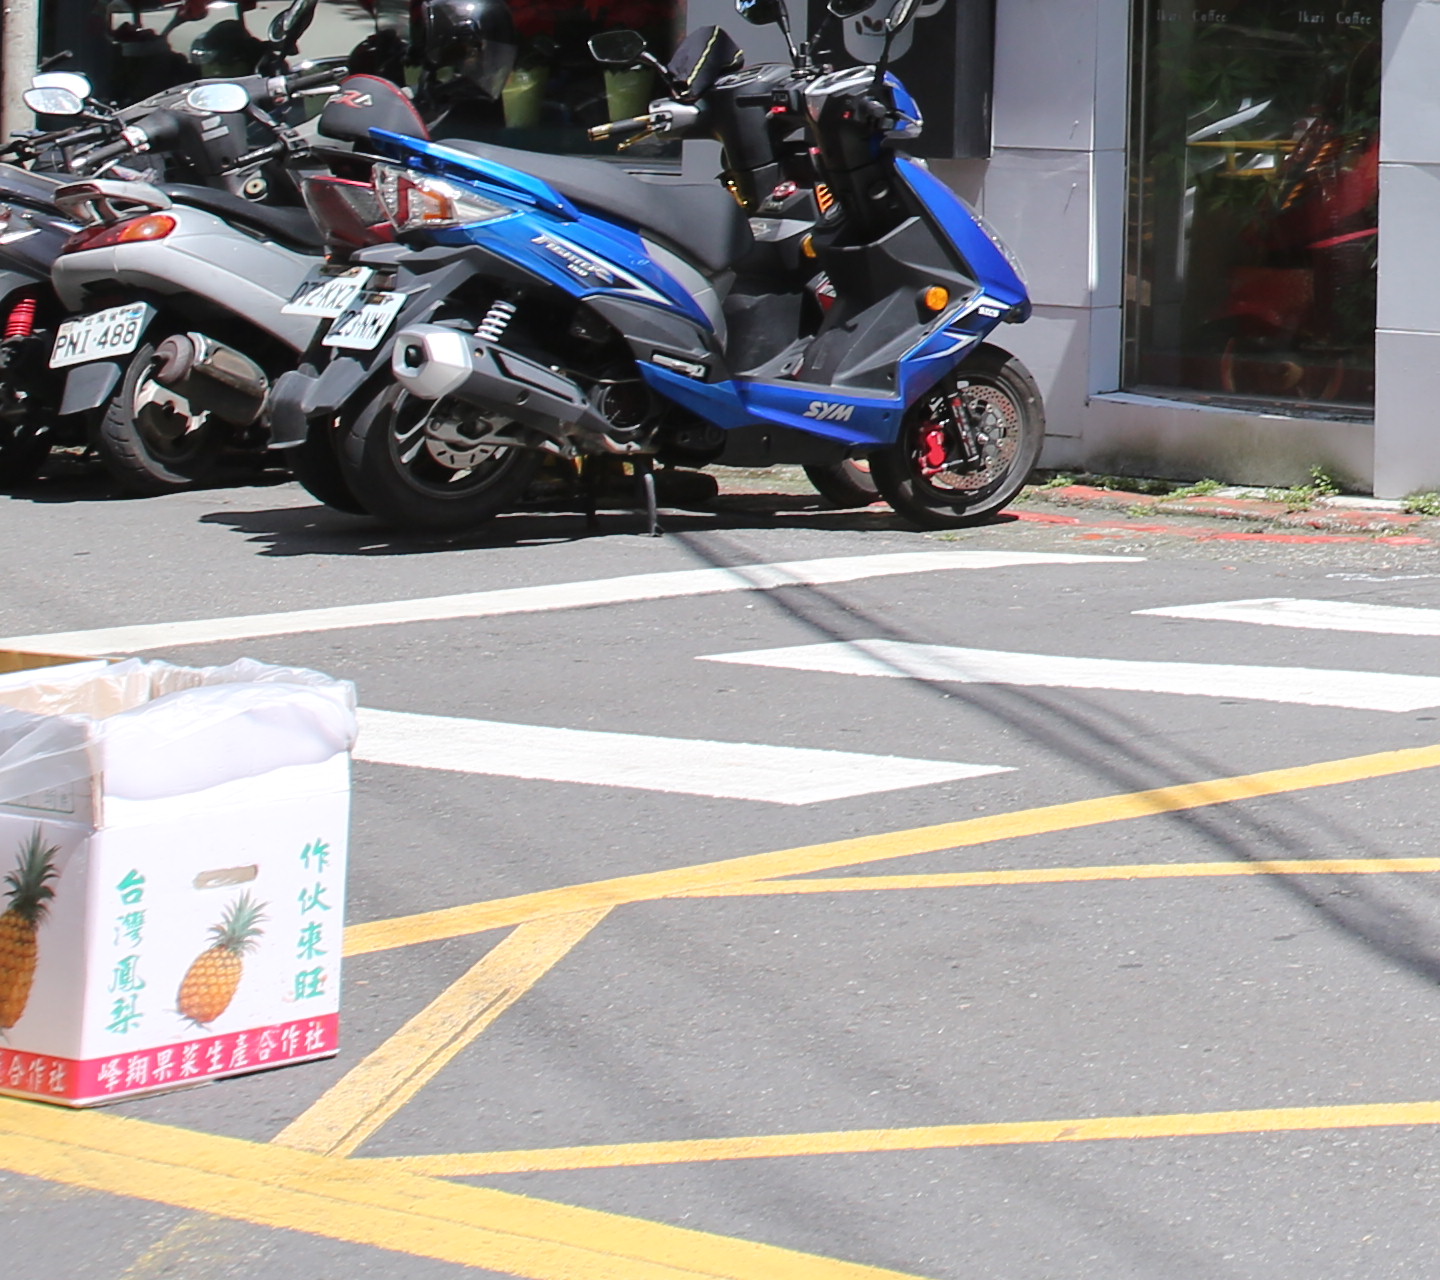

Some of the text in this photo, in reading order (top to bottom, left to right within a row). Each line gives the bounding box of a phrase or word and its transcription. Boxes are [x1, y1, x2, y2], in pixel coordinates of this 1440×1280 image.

[803, 400, 855, 422] SYM
[105, 868, 146, 1034] 台灣鳳梨
[294, 837, 332, 1002] 作伙來旺
